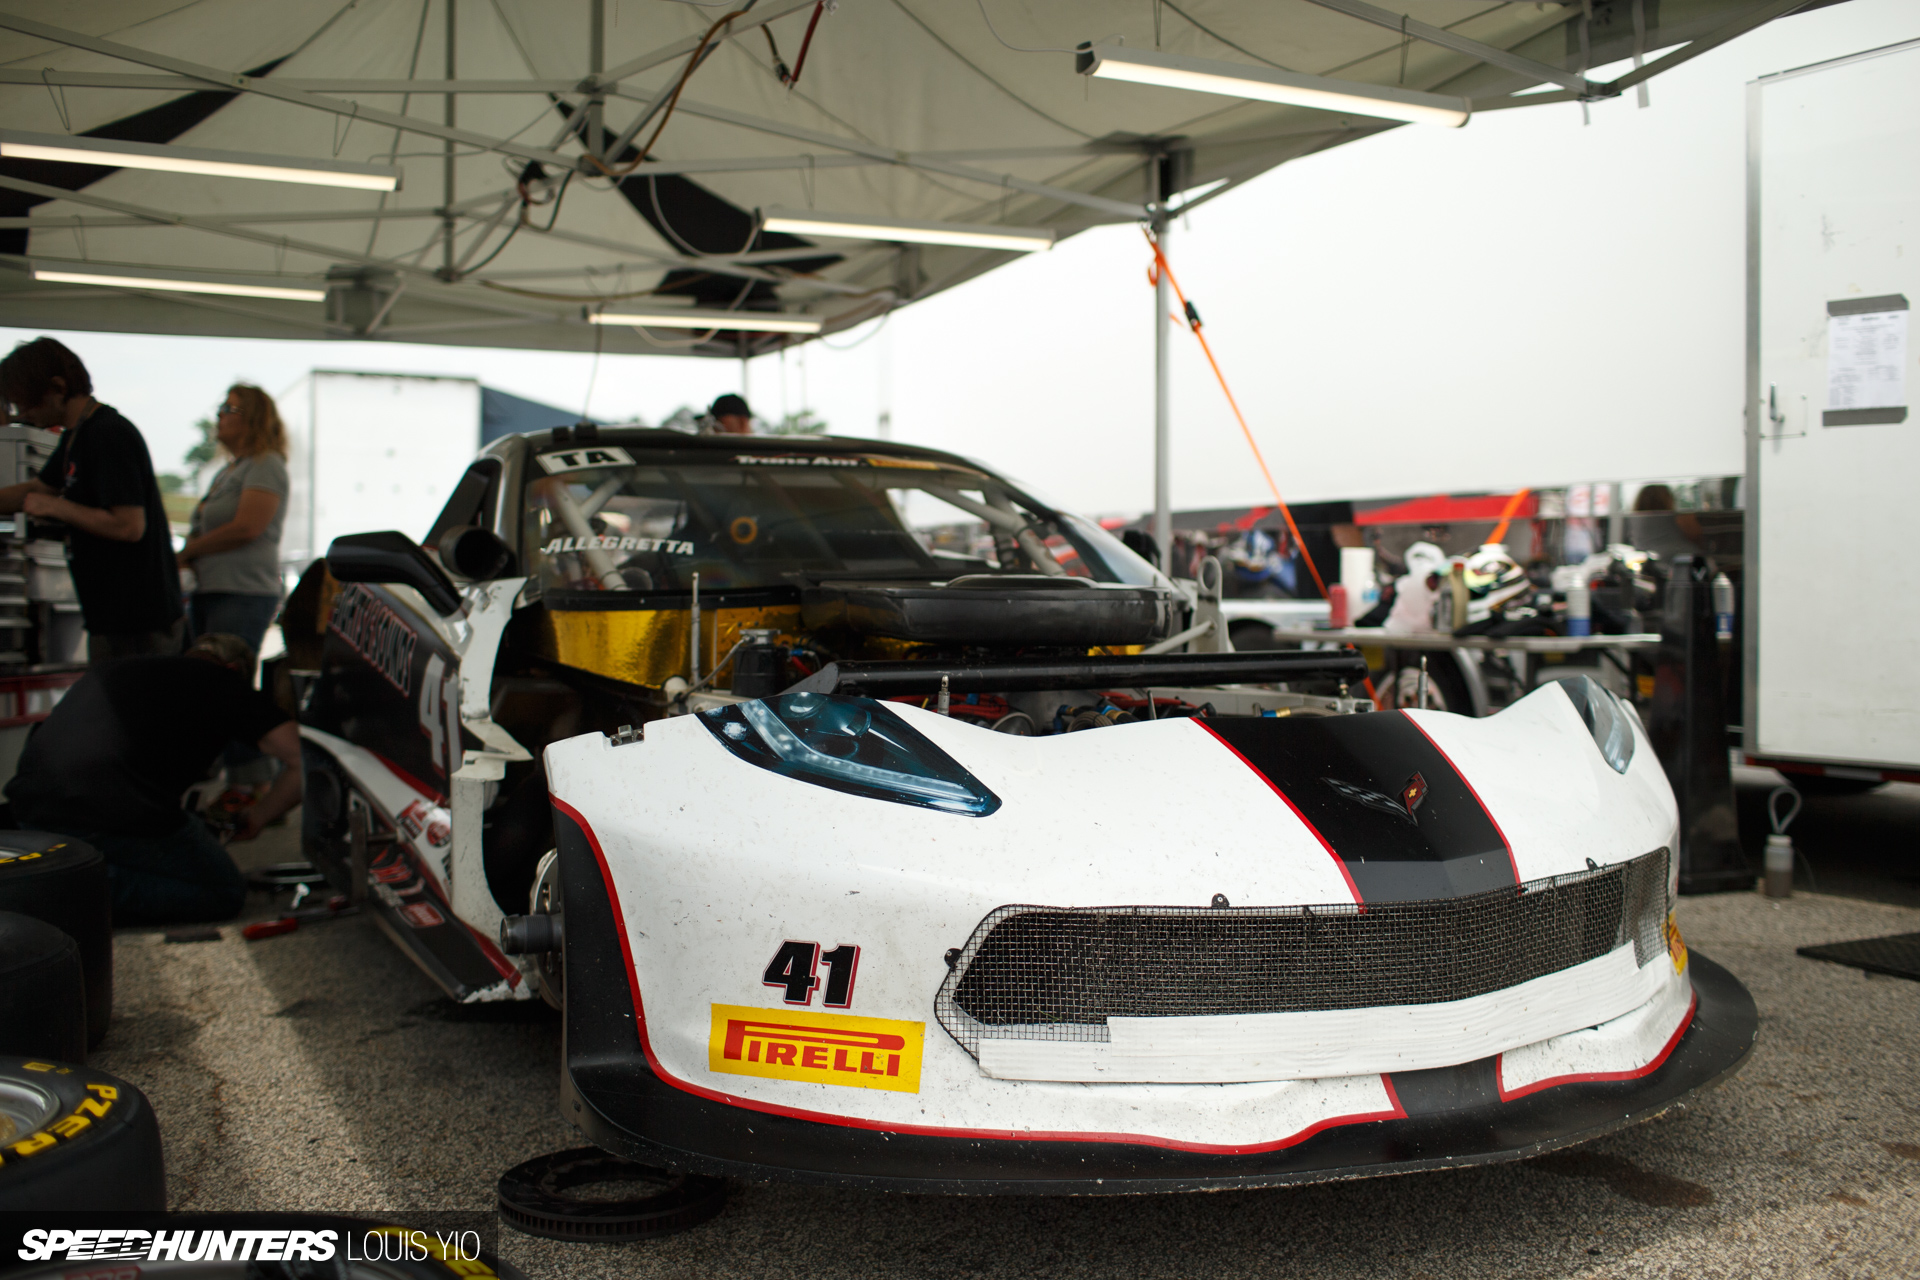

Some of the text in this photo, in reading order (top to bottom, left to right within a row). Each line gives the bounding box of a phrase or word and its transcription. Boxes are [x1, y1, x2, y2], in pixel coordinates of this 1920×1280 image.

[551, 451, 620, 467] TA
[734, 455, 809, 465] Trans
[811, 456, 858, 466] Am
[545, 536, 694, 555] ALLEGRETTA
[420, 650, 464, 780] 41
[762, 939, 861, 1009] 41
[724, 1019, 905, 1077] PIRELLI
